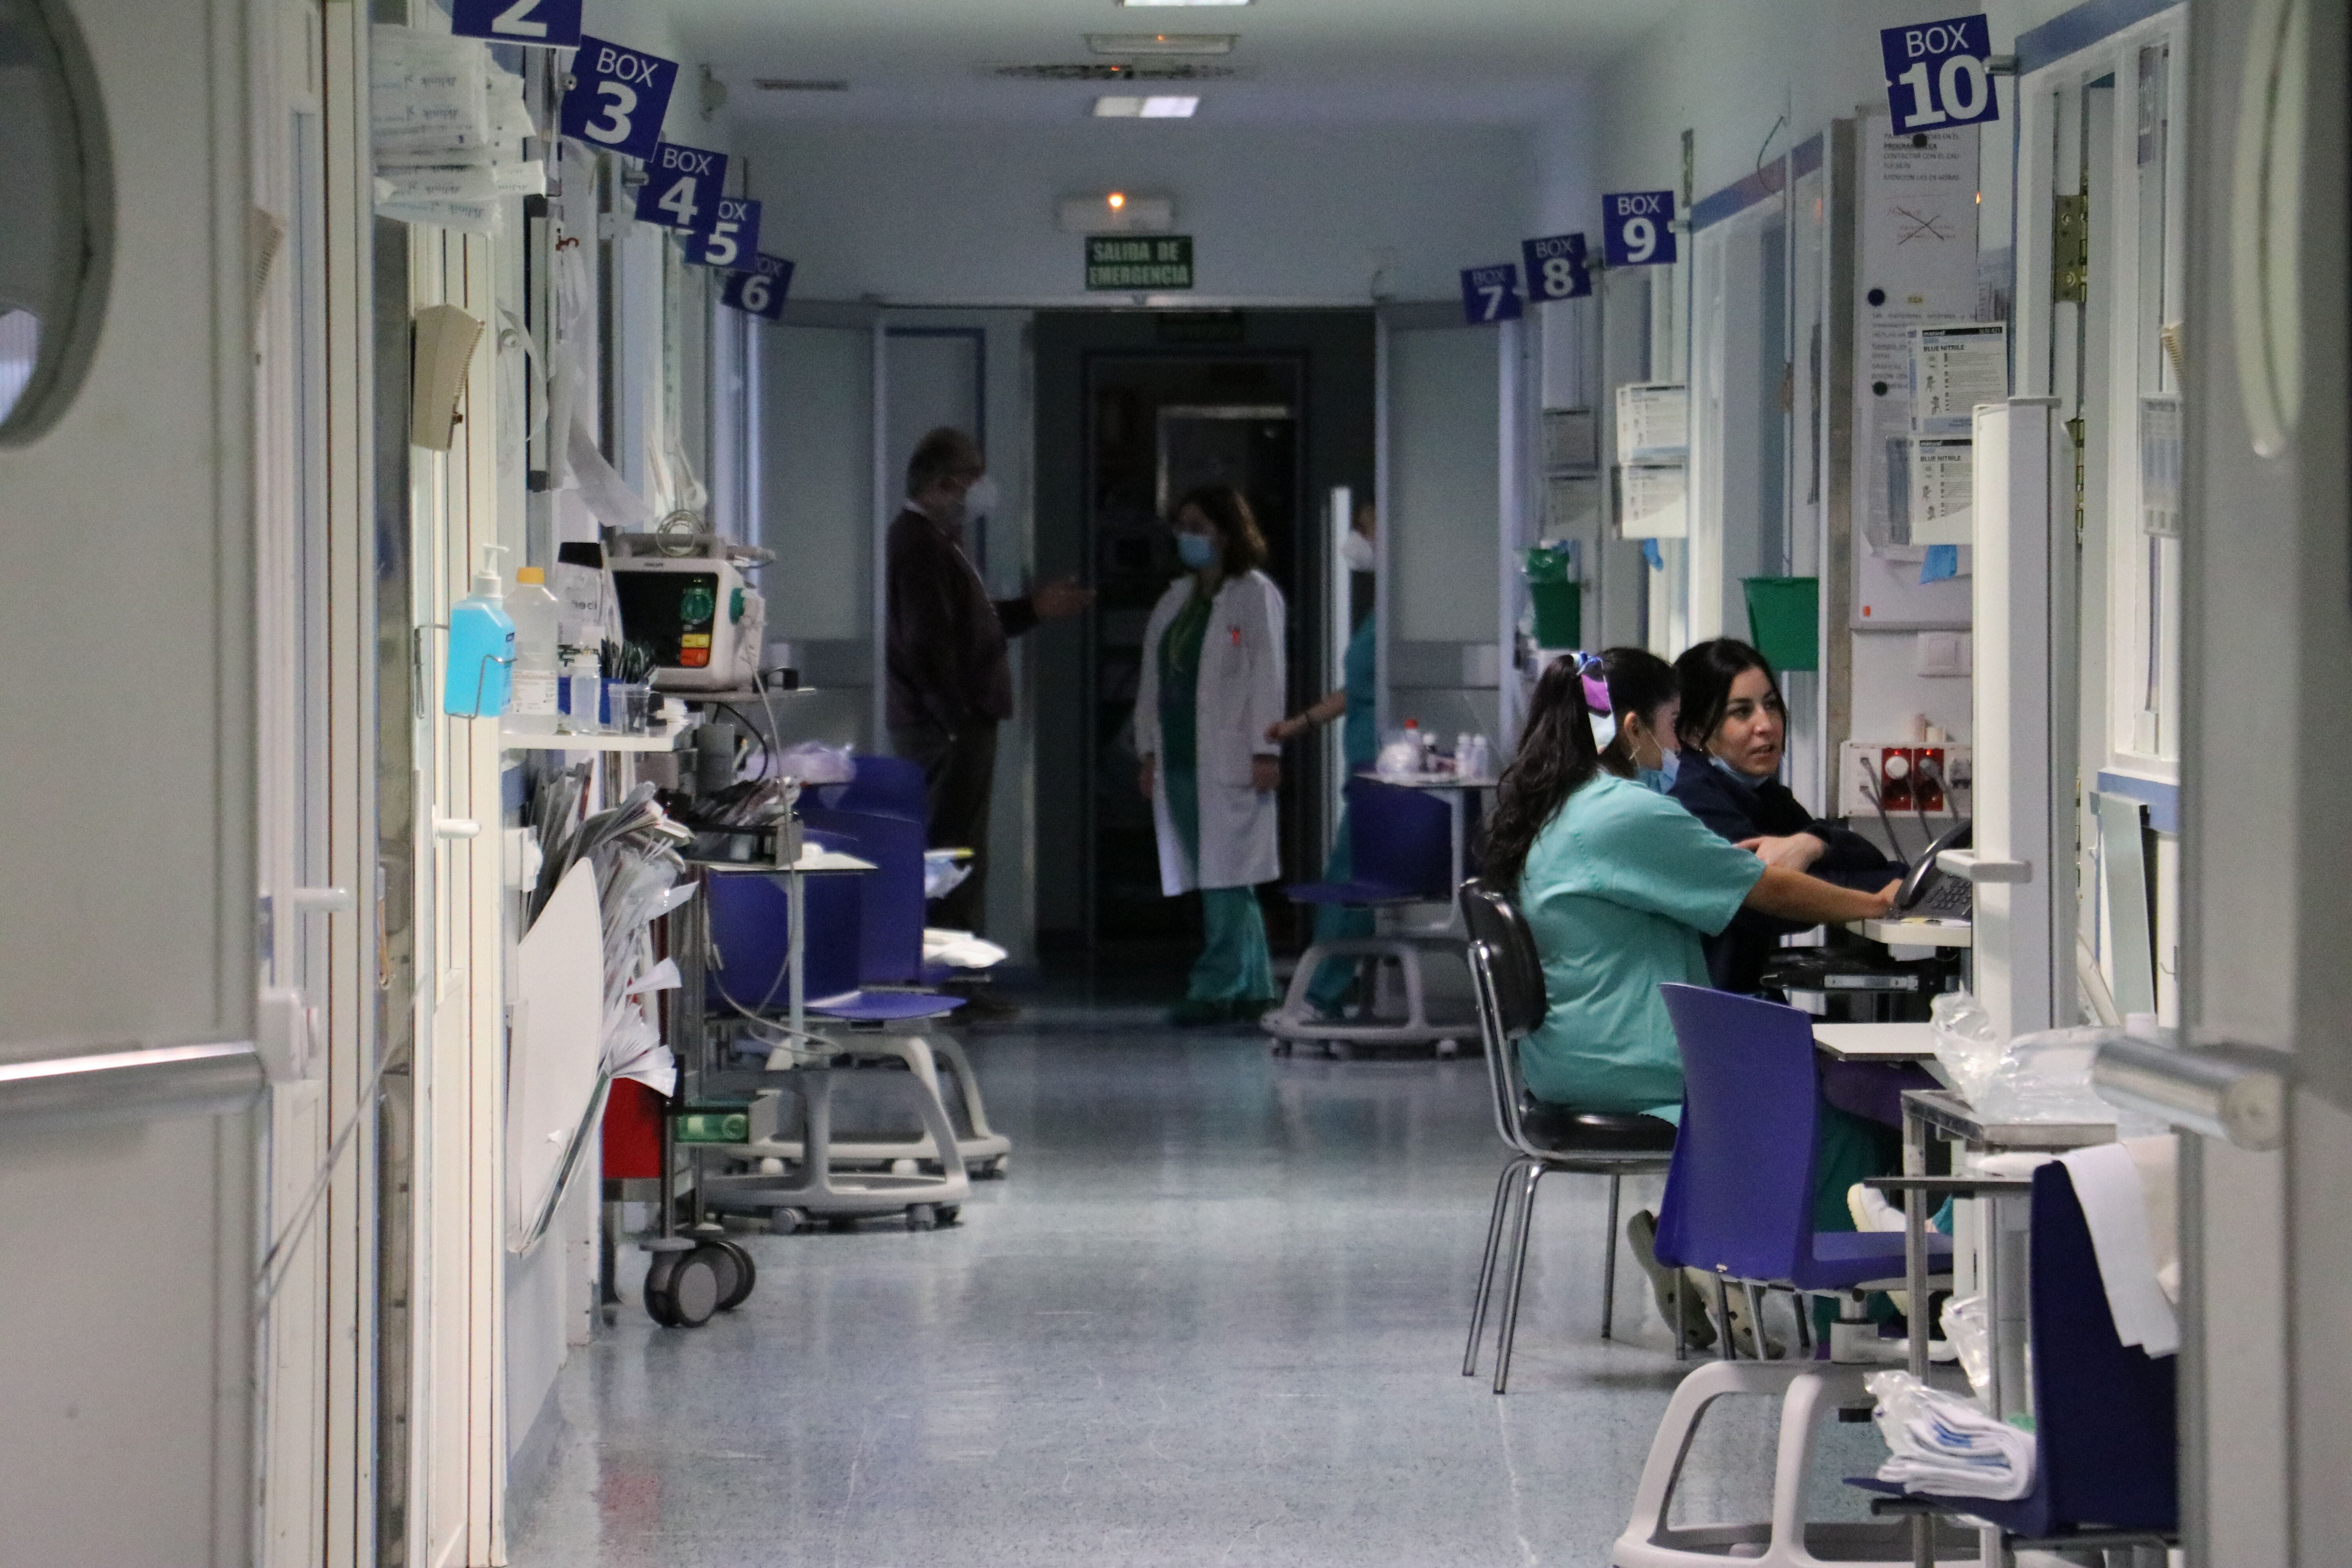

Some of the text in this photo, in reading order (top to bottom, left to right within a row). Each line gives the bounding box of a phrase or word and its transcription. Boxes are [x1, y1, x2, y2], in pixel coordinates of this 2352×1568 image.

[1906, 23, 1969, 58] BOX
[596, 47, 659, 88] BOX
[1899, 54, 1988, 128] 10
[584, 81, 638, 144] 3
[662, 147, 712, 176] BOX
[659, 176, 698, 225] 4
[718, 200, 748, 221] OX
[1617, 196, 1661, 216] BOX
[706, 221, 739, 265] 5
[1157, 241, 1179, 261] DE
[1535, 238, 1573, 259] BOX
[1622, 217, 1657, 263] 9
[757, 258, 782, 277] OX
[1543, 258, 1573, 297] 8
[741, 274, 771, 311] 6
[1478, 285, 1503, 320] 7
